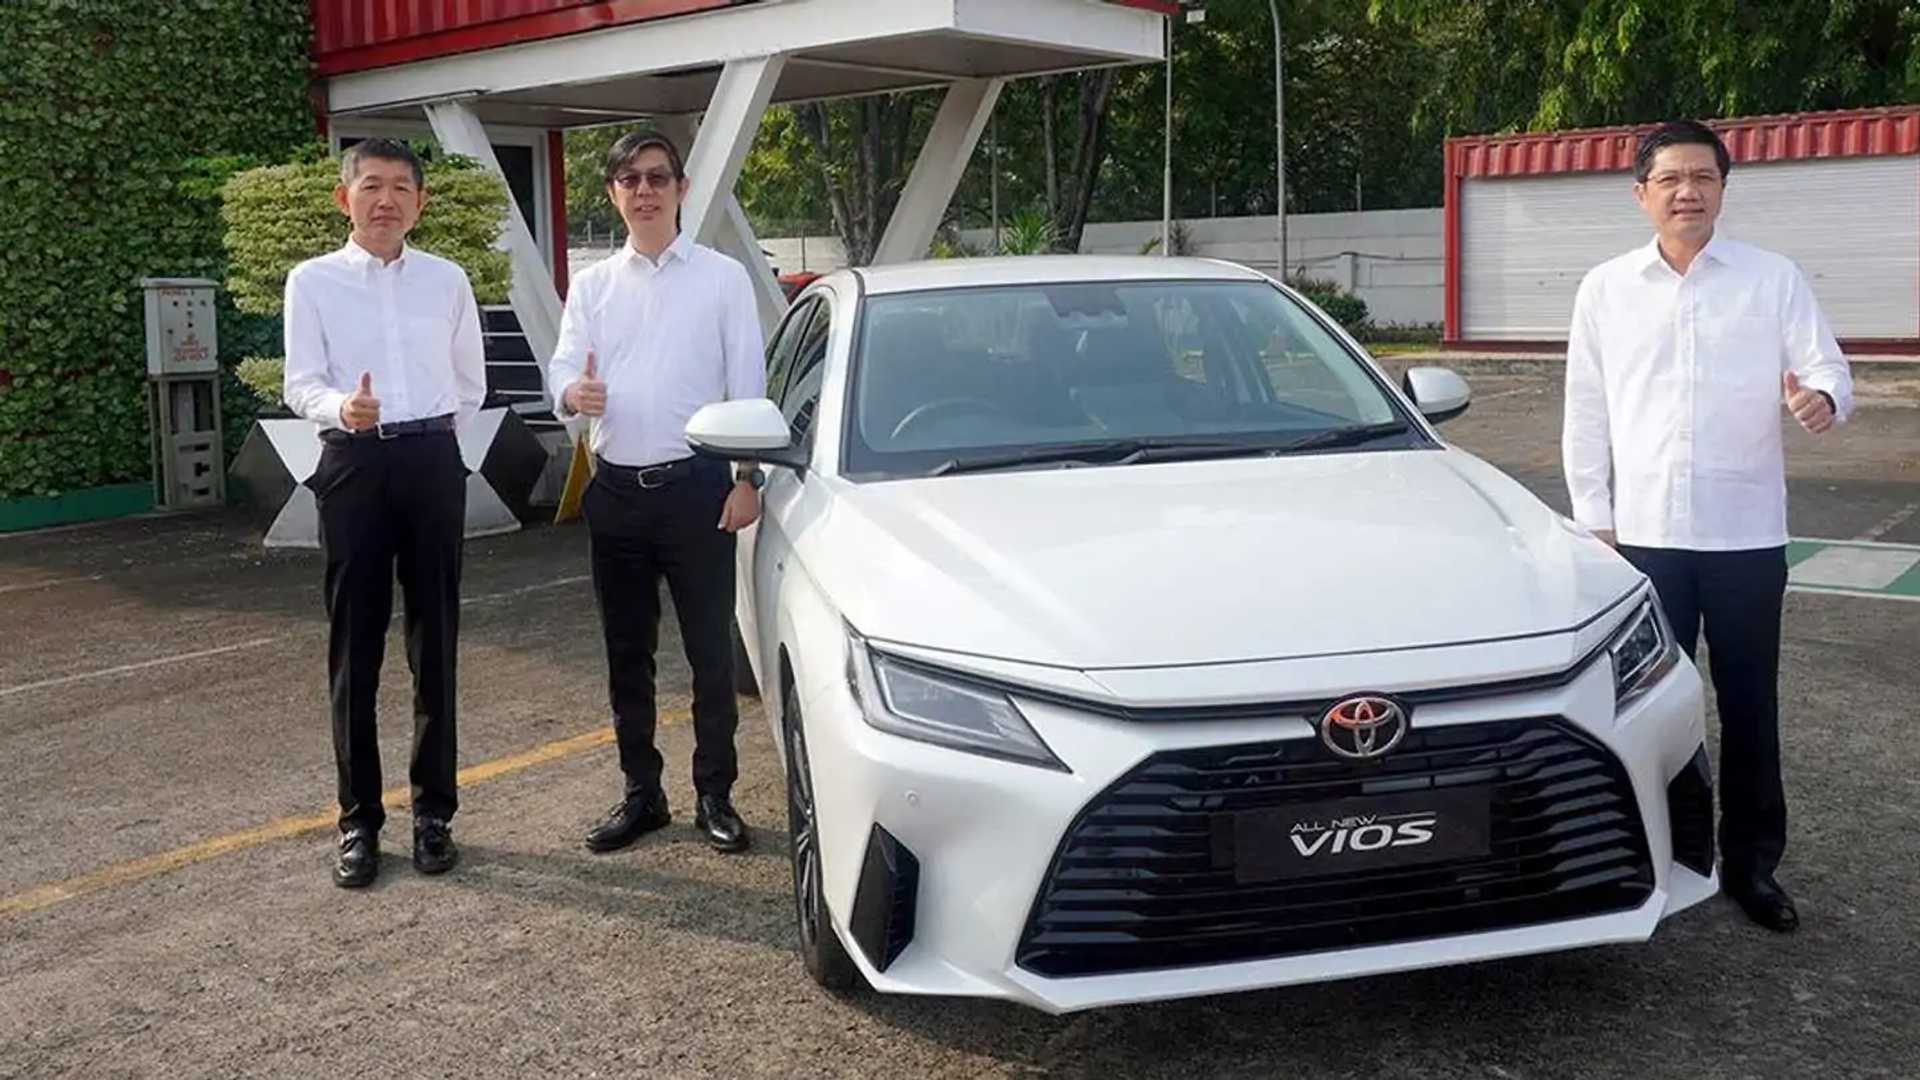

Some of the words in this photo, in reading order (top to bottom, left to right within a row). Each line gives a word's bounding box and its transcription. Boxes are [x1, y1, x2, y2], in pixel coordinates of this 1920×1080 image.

[1290, 821, 1325, 833] ALL
[1331, 814, 1376, 829] NEW
[1290, 819, 1436, 856] VIOS
